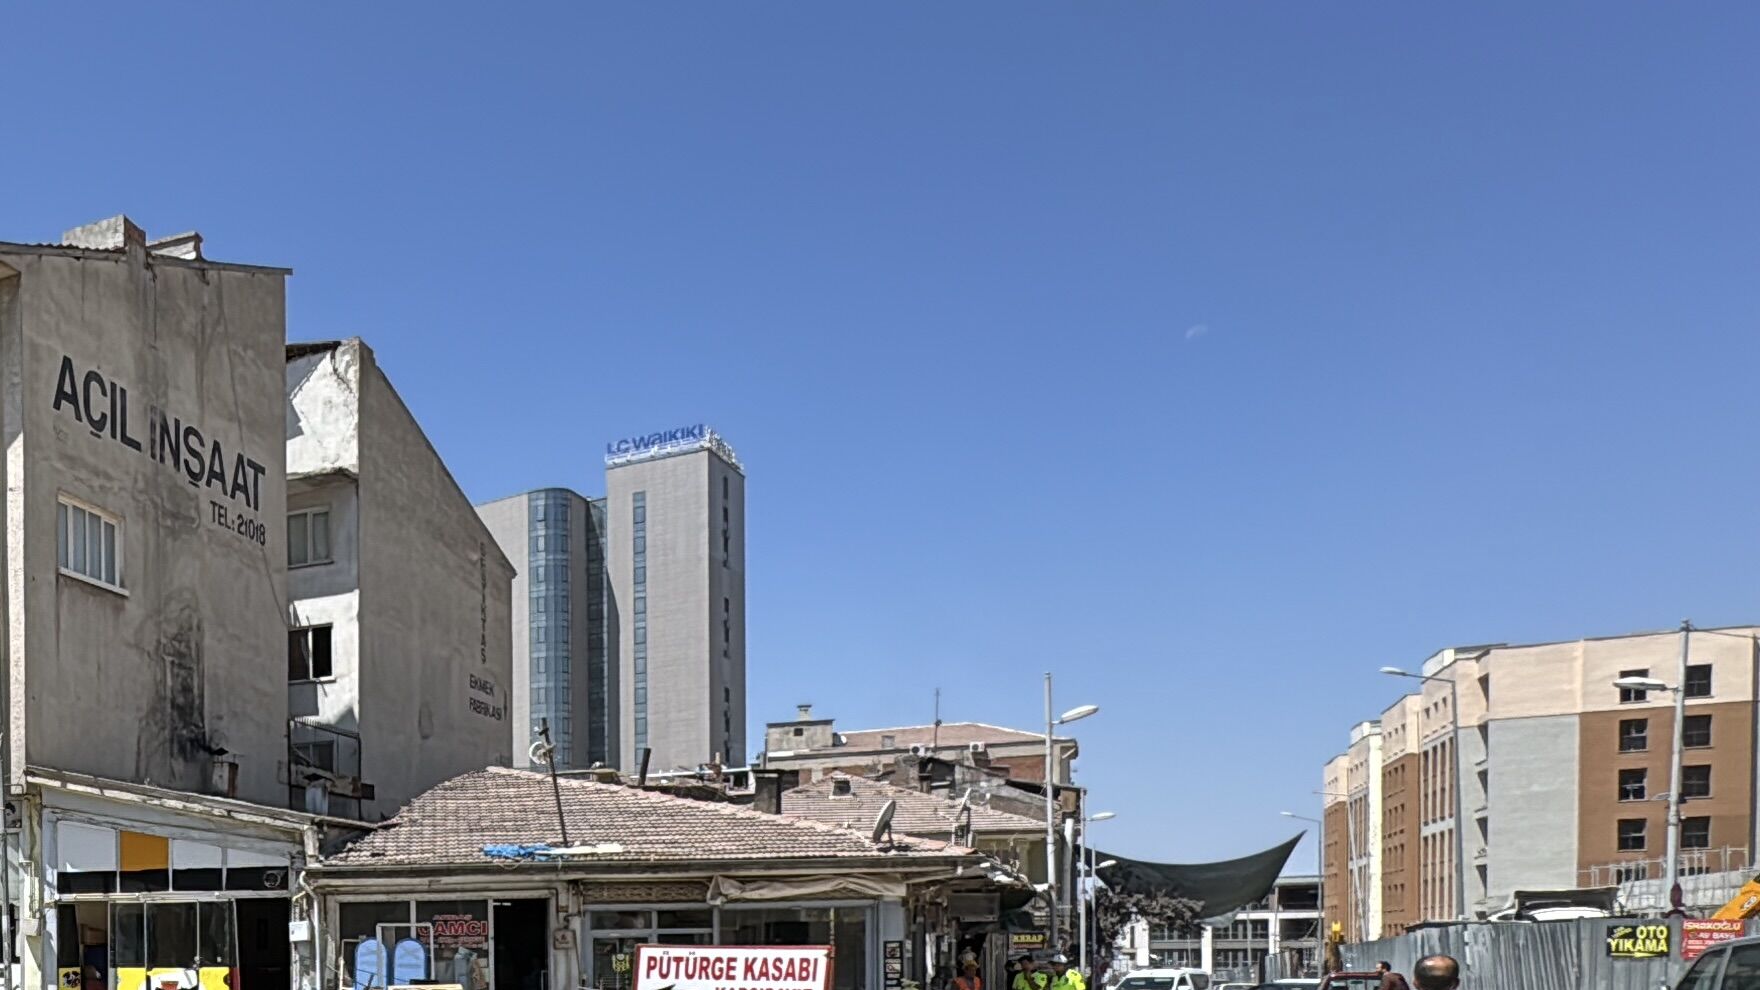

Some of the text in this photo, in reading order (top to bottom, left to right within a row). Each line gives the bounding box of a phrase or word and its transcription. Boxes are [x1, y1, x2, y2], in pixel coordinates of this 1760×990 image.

[210, 500, 266, 546] TEL: 21018
[1636, 926, 1668, 939] OTO
[1608, 938, 1668, 952] YIKAMA
[646, 951, 819, 981] PÜTÜRGE KASABI
